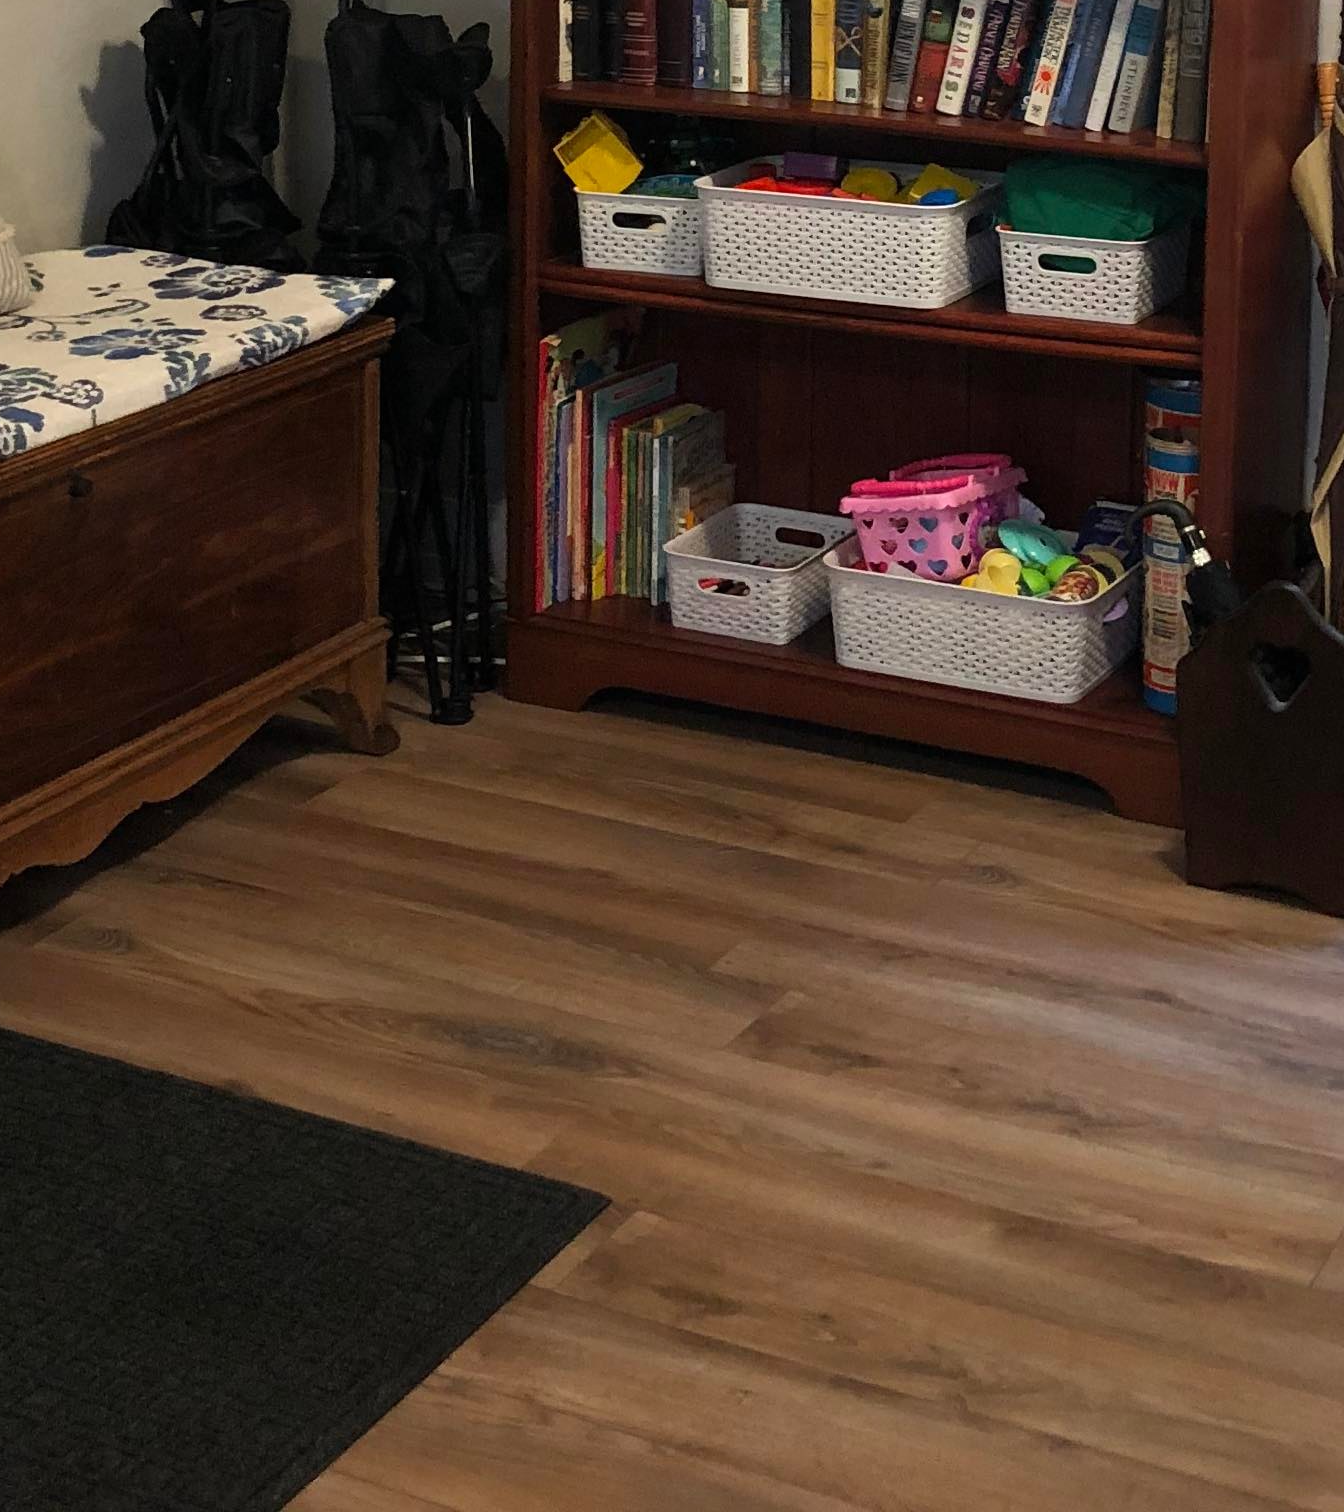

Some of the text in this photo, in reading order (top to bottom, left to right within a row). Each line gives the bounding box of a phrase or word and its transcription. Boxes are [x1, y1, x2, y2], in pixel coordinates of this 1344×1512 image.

[897, 20, 917, 40] DEN
[894, 40, 913, 53] OF
[889, 53, 910, 85] LIONS
[1115, 59, 1138, 123] STEINBECK
